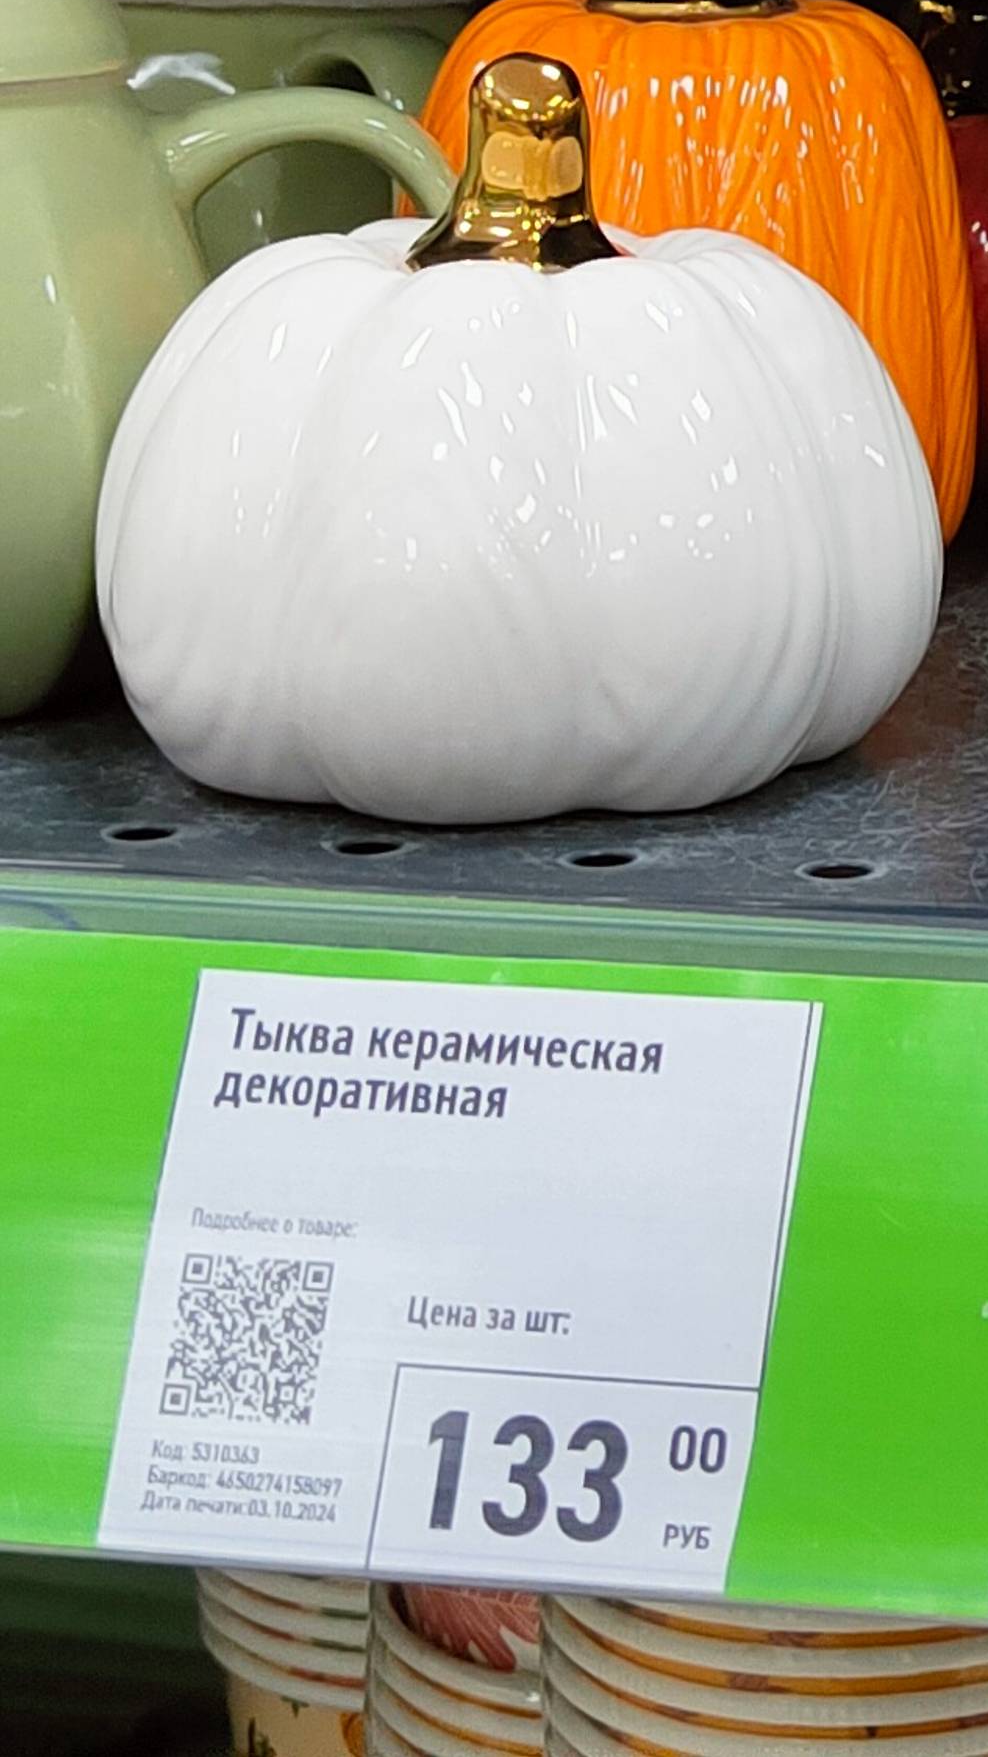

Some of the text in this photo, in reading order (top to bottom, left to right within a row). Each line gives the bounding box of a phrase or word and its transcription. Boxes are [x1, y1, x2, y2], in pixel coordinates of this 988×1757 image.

[230, 1008, 664, 1075] Тыква керамическая
[214, 1071, 509, 1118] декоративная
[192, 1207, 358, 1242] Подробнее о товаре:
[408, 1296, 571, 1335] Цена за шт:
[152, 1440, 260, 1464] Код: 5310363
[148, 1465, 342, 1497] Баркод: 4650274158097
[427, 1408, 727, 1543] 133 00
[140, 1490, 182, 1512] Дата
[663, 1523, 711, 1551] РУБ
